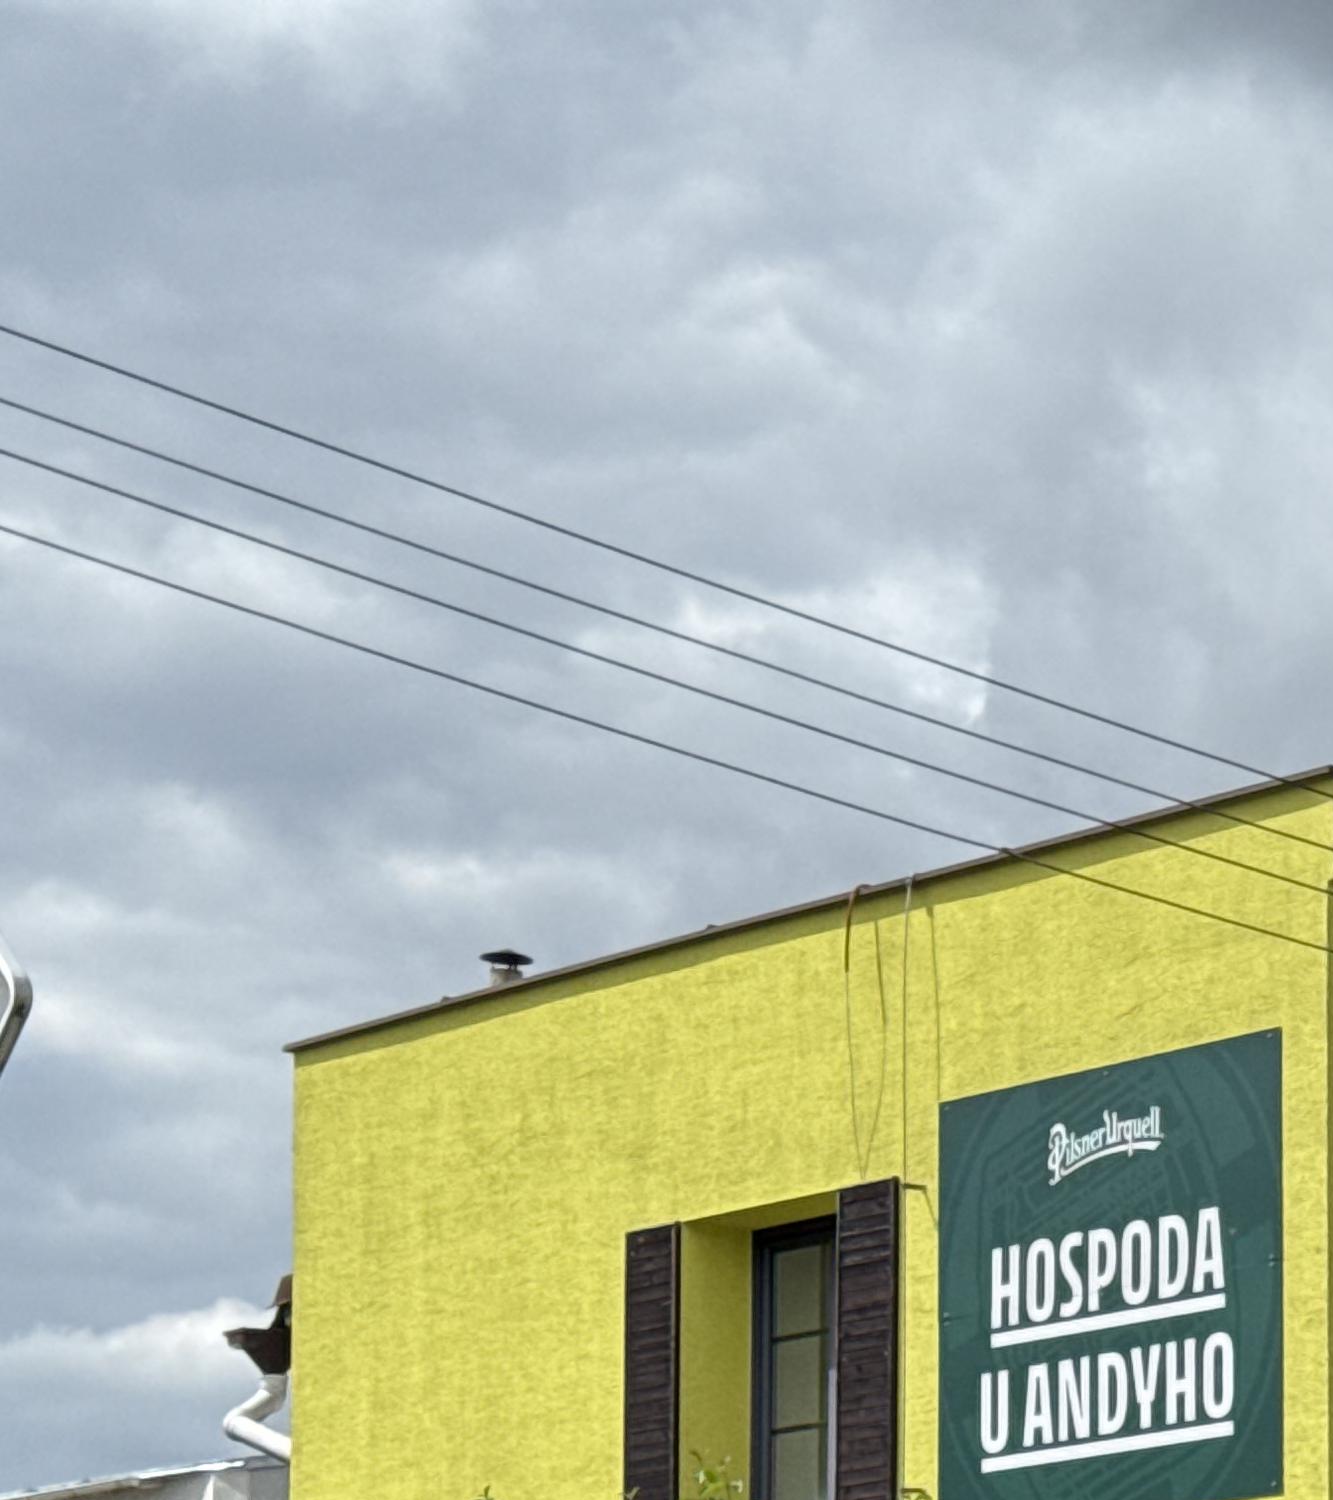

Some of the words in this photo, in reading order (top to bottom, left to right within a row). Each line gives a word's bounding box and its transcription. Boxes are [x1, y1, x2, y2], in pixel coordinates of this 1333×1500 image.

[1047, 1123, 1105, 1186] Pilsner
[1103, 1105, 1161, 1158] Urquell
[991, 1206, 1226, 1330] HOSPODA
[980, 1369, 1009, 1454] U
[1022, 1331, 1235, 1448] ANDYHO
